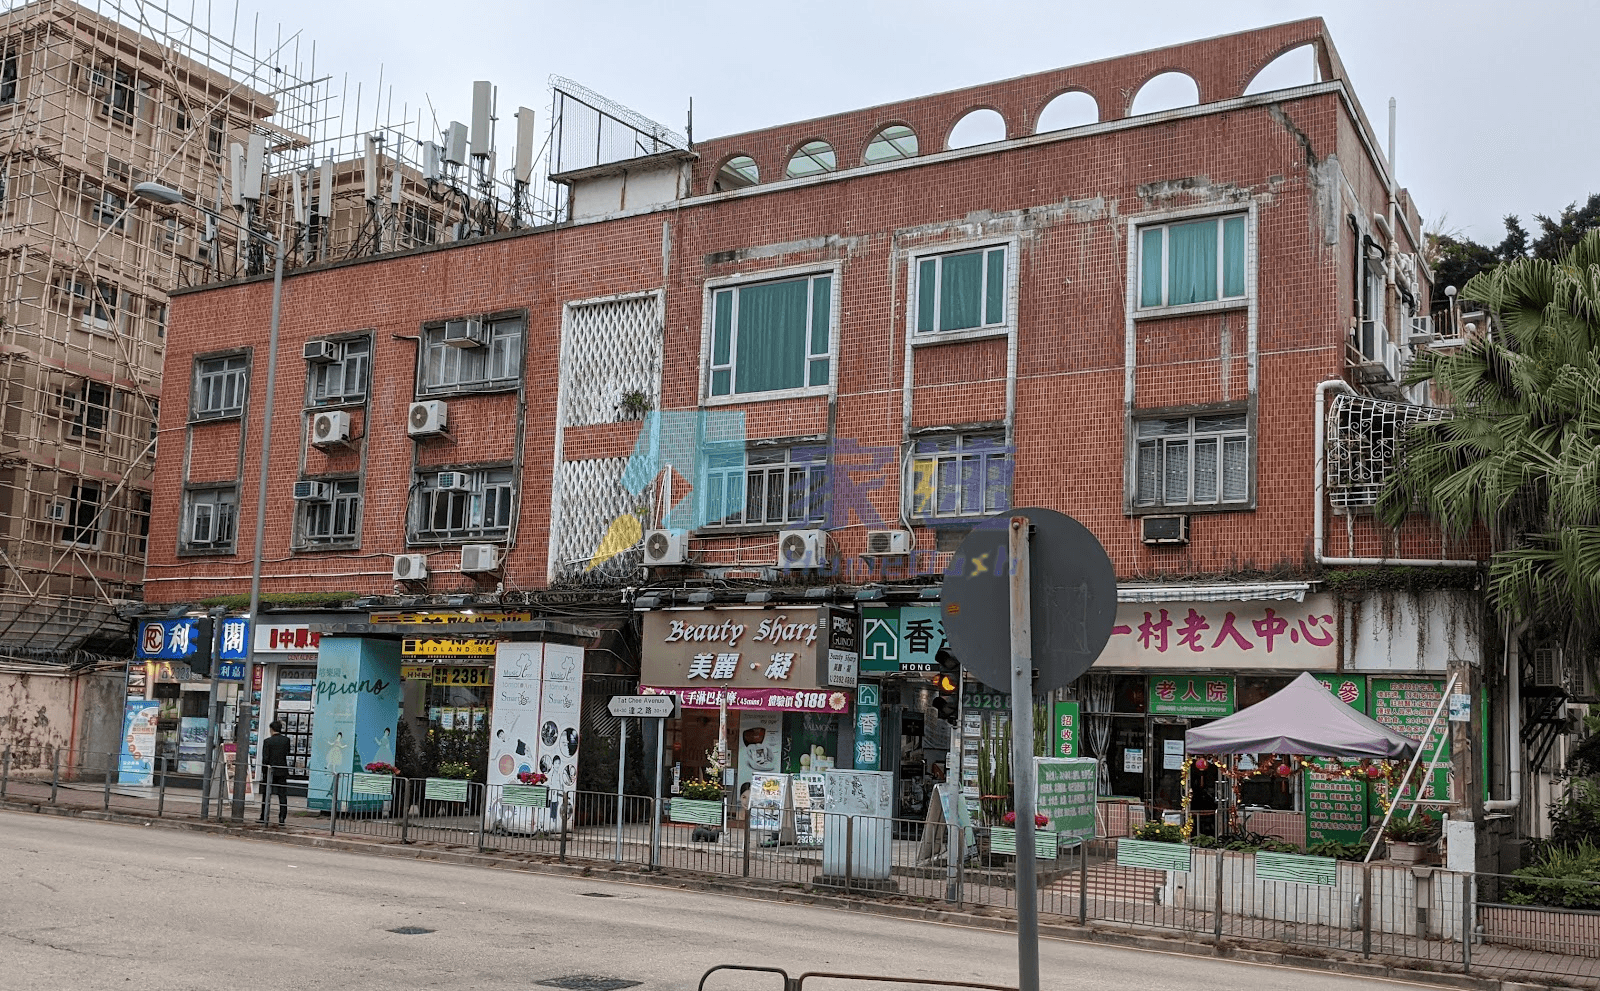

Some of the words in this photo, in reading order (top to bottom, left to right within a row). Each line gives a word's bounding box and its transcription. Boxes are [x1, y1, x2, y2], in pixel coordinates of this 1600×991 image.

[168, 622, 246, 654] 利閣
[664, 619, 744, 647] Beauty
[452, 669, 486, 684] 2381
[794, 691, 827, 709] $188
[963, 694, 1001, 708] 2928
[1156, 680, 1229, 702] 老人院
[629, 706, 652, 714] 達之路
[856, 712, 879, 765] 香港
[1061, 714, 1073, 755] 招收老
